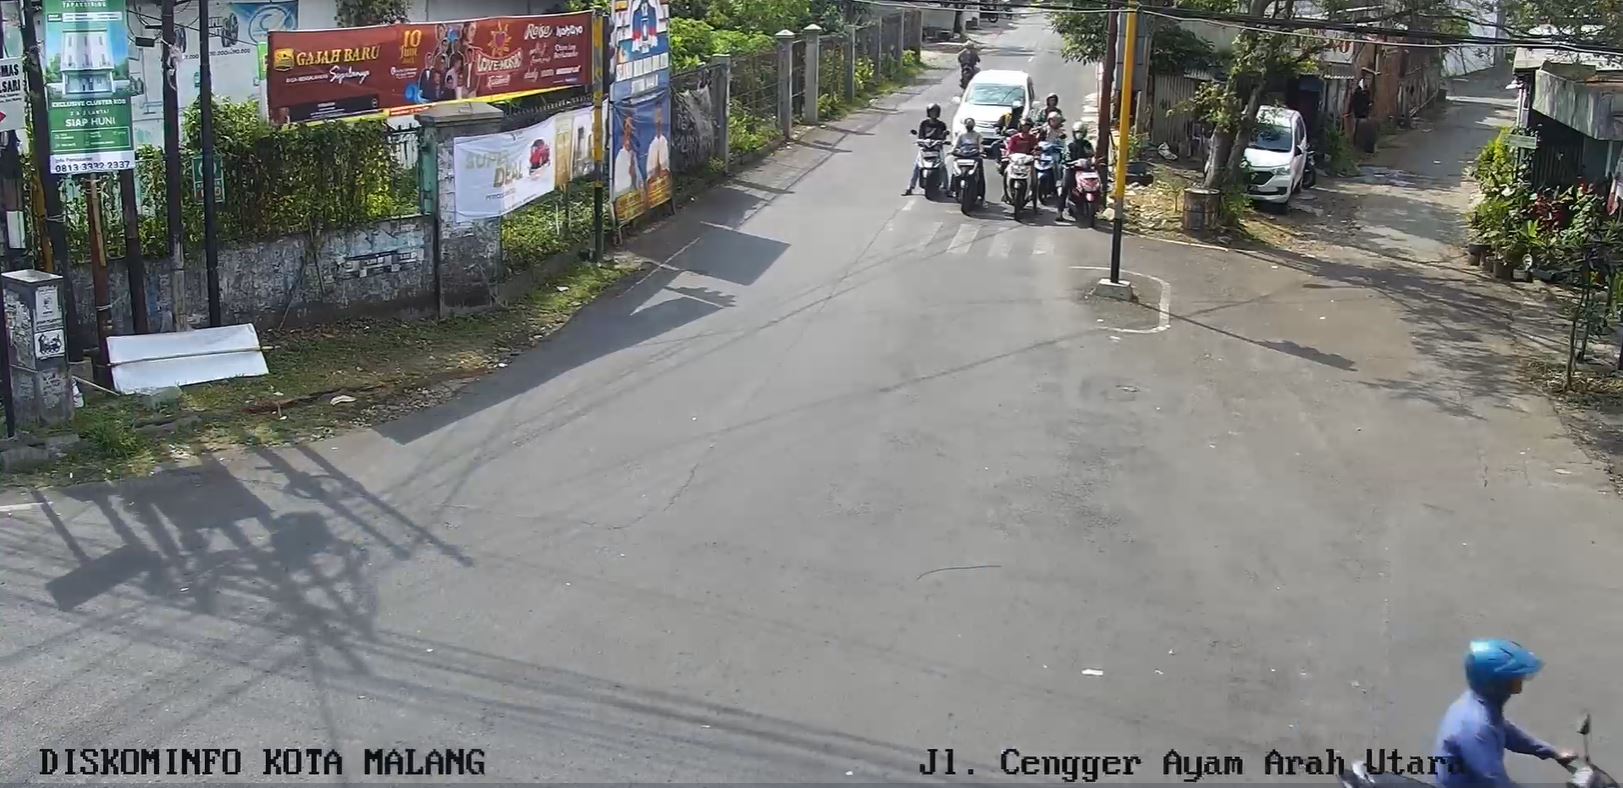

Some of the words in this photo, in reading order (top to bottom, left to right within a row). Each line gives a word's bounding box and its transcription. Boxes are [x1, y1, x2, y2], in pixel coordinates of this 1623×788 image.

[403, 29, 422, 48] 10
[296, 48, 342, 66] GAJAH
[343, 45, 381, 62] BARU
[0, 63, 20, 77] MAS
[0, 79, 21, 94] SARI
[65, 117, 88, 127] SIAP
[90, 116, 116, 126] HUNI
[55, 163, 79, 173] 0813
